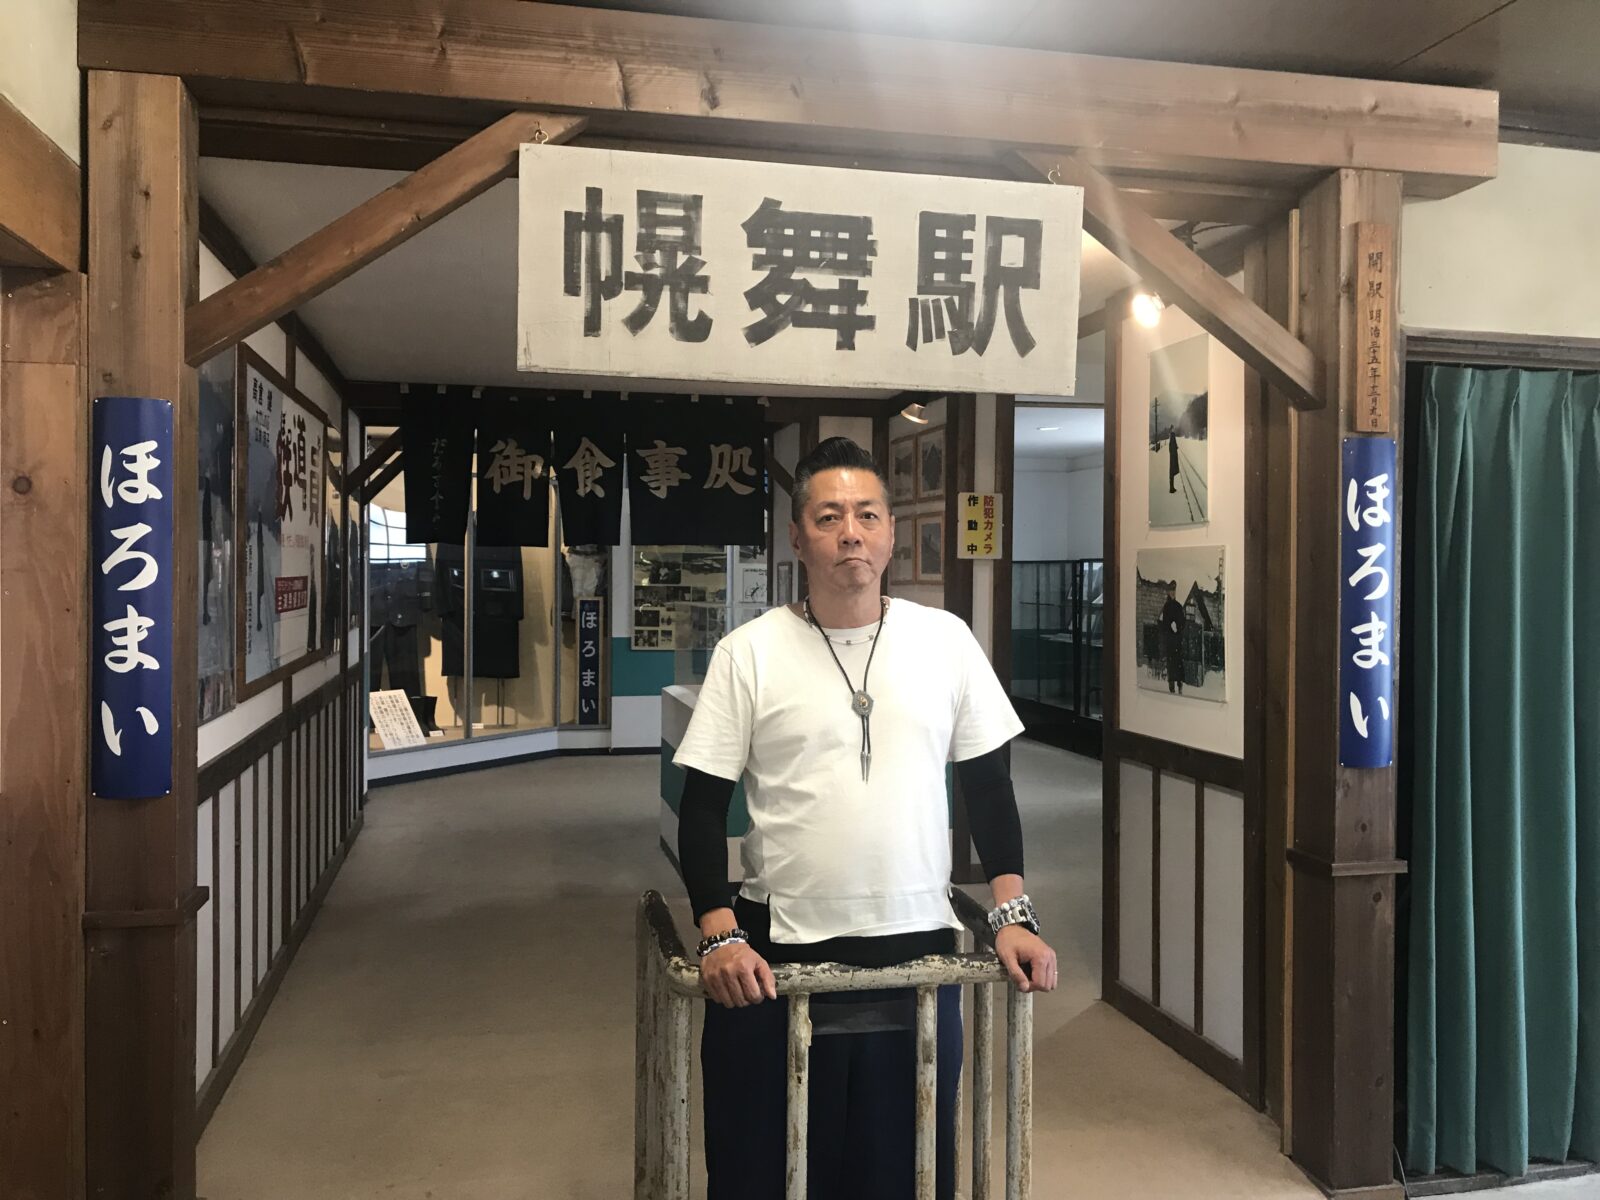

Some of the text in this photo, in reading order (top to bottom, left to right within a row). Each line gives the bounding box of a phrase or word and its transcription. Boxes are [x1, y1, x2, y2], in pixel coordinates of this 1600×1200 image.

[564, 186, 1043, 359] 幌舞駅
[484, 436, 756, 500] 御食事処
[967, 495, 979, 555] 作動中
[984, 495, 995, 554] 防犯カメラ
[100, 440, 163, 757] ほろまい
[1347, 472, 1392, 739] ほろまい
[581, 610, 599, 714] ほろまい
